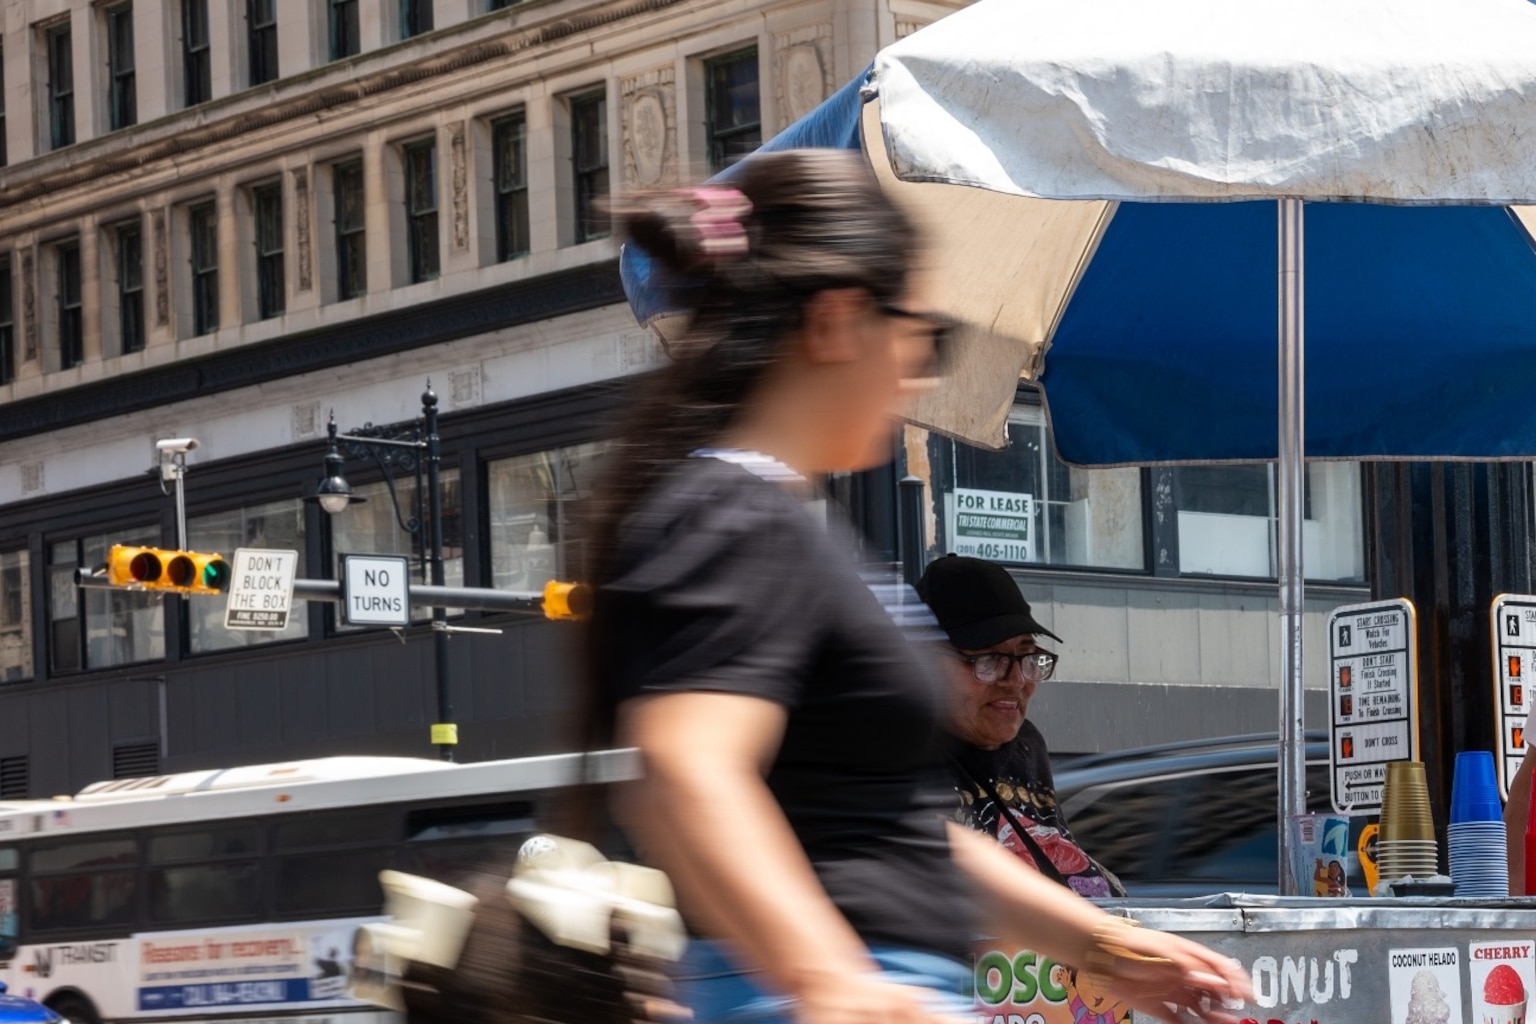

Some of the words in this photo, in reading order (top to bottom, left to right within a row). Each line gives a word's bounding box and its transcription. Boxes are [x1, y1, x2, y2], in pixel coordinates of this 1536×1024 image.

[957, 494, 985, 509] FOR
[990, 497, 1028, 513] LEASE
[956, 544, 975, 555] (201)
[977, 543, 1027, 560] 405-1110
[248, 557, 283, 572] DON'T
[243, 575, 281, 590] BLOCK
[364, 569, 390, 587] NO
[235, 593, 256, 608] THE
[263, 594, 286, 609] BOX
[353, 596, 402, 612] TURNS
[1357, 616, 1371, 627] START
[1374, 614, 1399, 625] CROSSING
[1363, 656, 1378, 667] DON'T
[1380, 654, 1395, 665] START
[1358, 697, 1370, 707] TIME
[1372, 693, 1401, 705] REMAINING
[1364, 737, 1380, 749] DON'T
[1381, 735, 1398, 747] CROSS
[1344, 770, 1361, 781] PUSH
[1363, 768, 1372, 779] OR
[1374, 767, 1386, 778] WA
[1344, 790, 1370, 802] BUTTON
[1371, 790, 1379, 800] TO
[1392, 953, 1427, 968] COCONUT
[1428, 952, 1456, 966] HELADO
[1473, 945, 1531, 961] CHERRY
